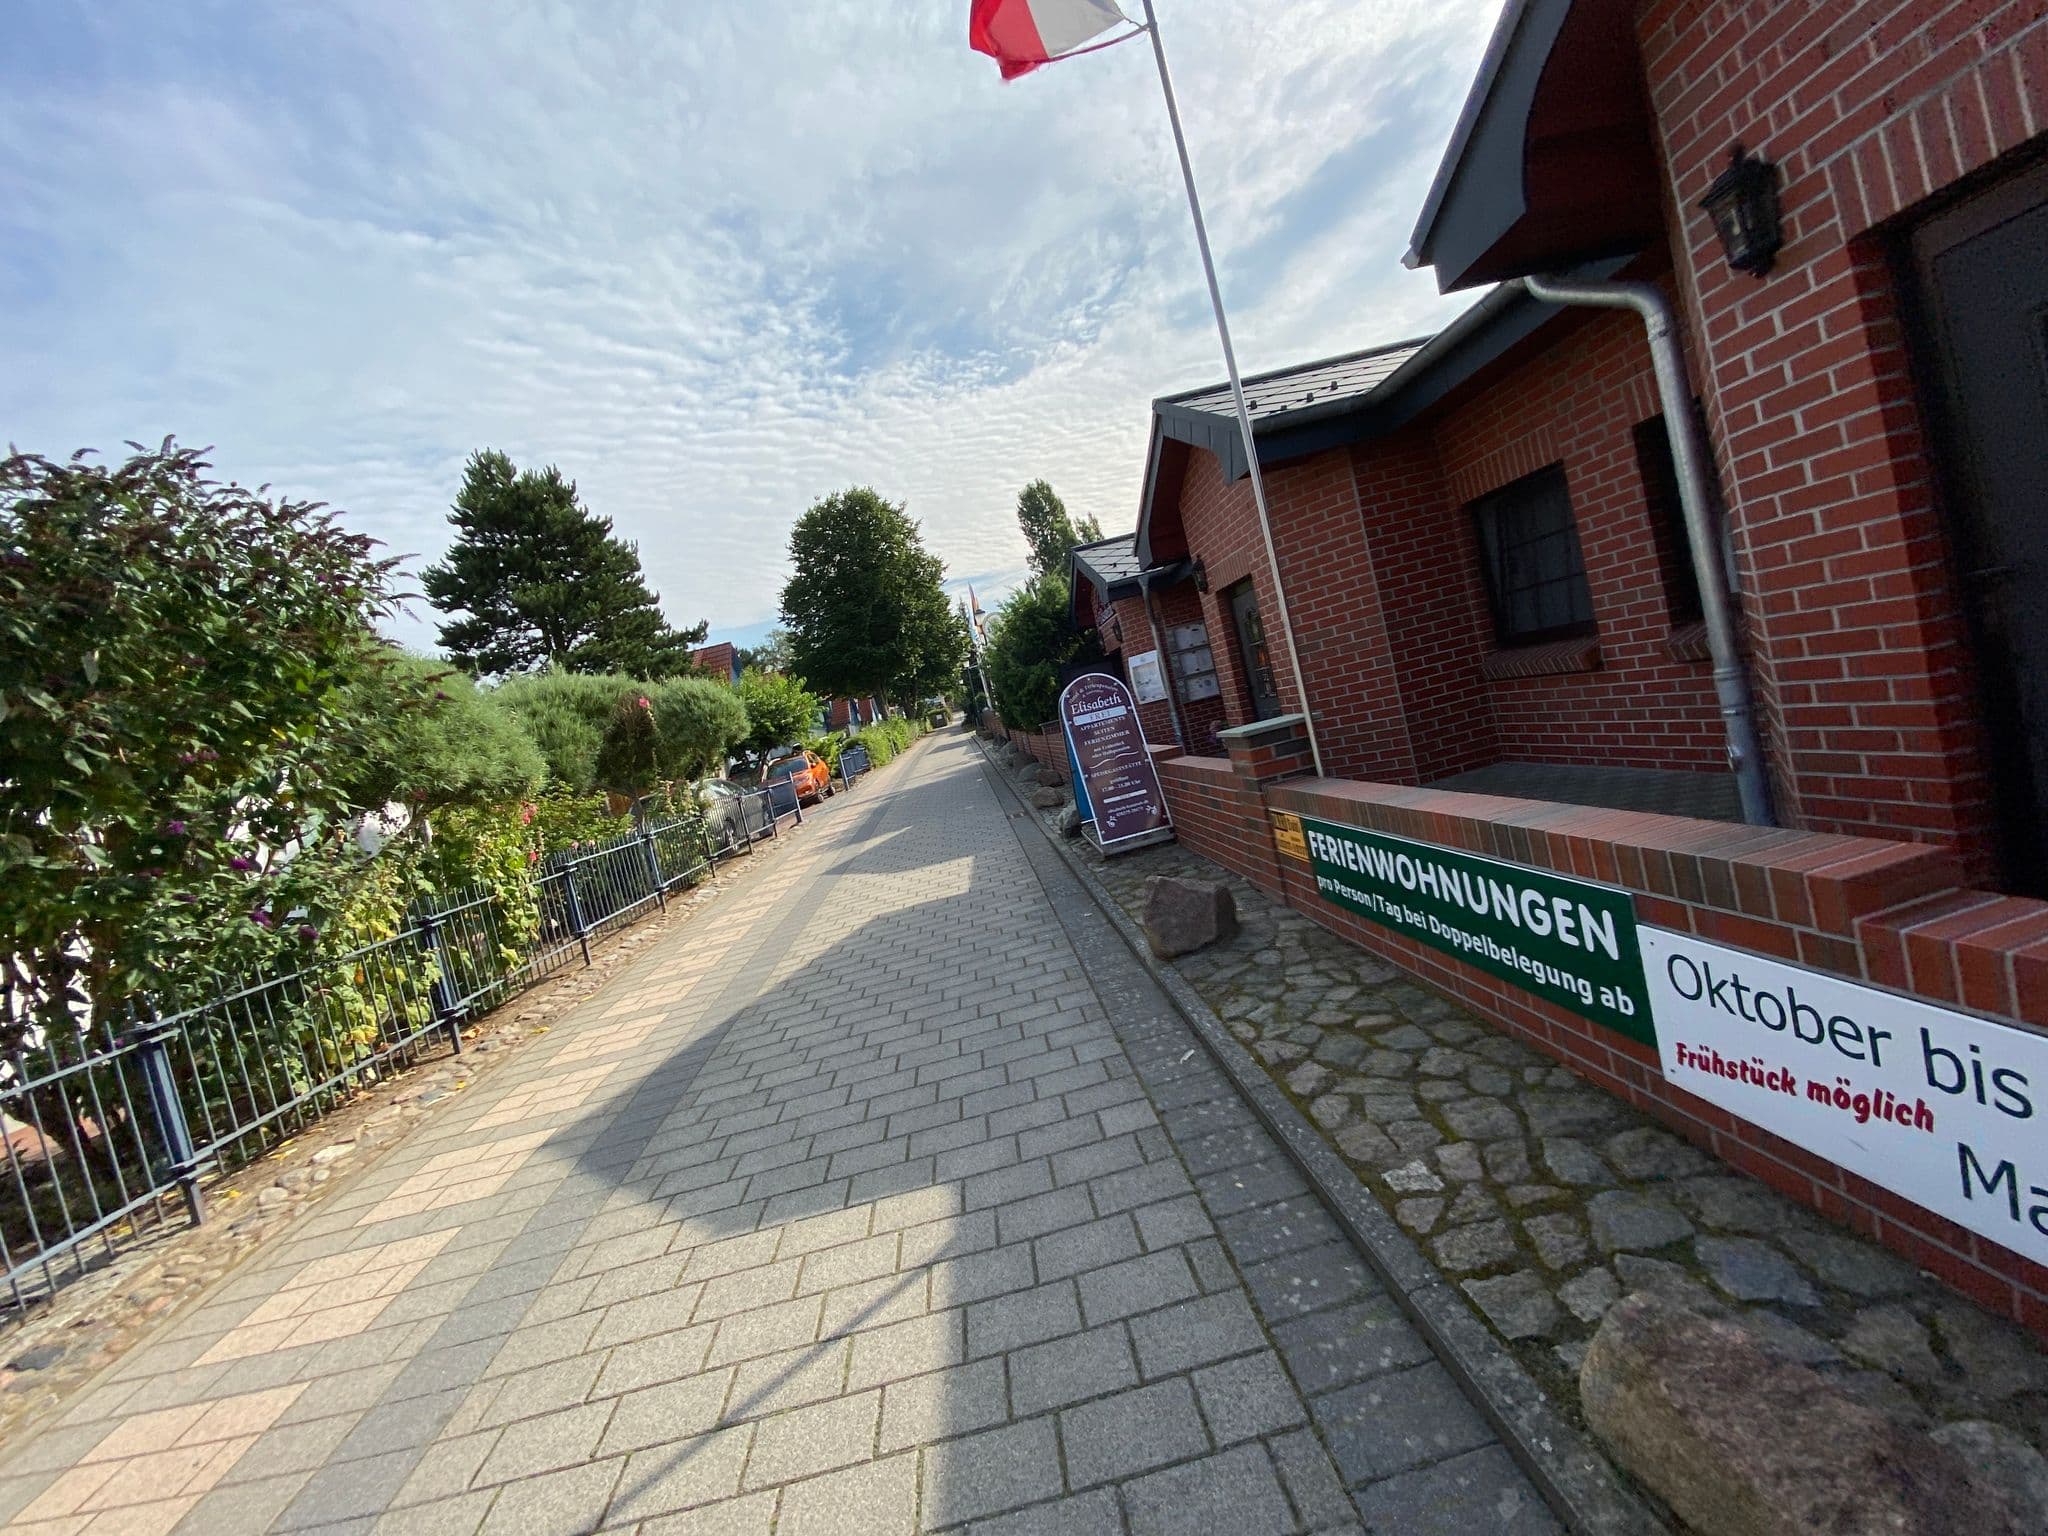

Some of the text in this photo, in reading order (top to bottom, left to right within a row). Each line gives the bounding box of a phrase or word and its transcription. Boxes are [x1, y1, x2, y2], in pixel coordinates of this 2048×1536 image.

[1071, 692, 1122, 715] Elisabeth
[1089, 710, 1112, 720] FREI
[1307, 830, 1619, 960] FERIENWOHNUNGEN
[1317, 874, 1635, 1016] pro Person/Tag bei Doppelbelegung ab
[1667, 953, 2034, 1119] Oktober bis
[1675, 1041, 1936, 1133] Frühstück möglich
